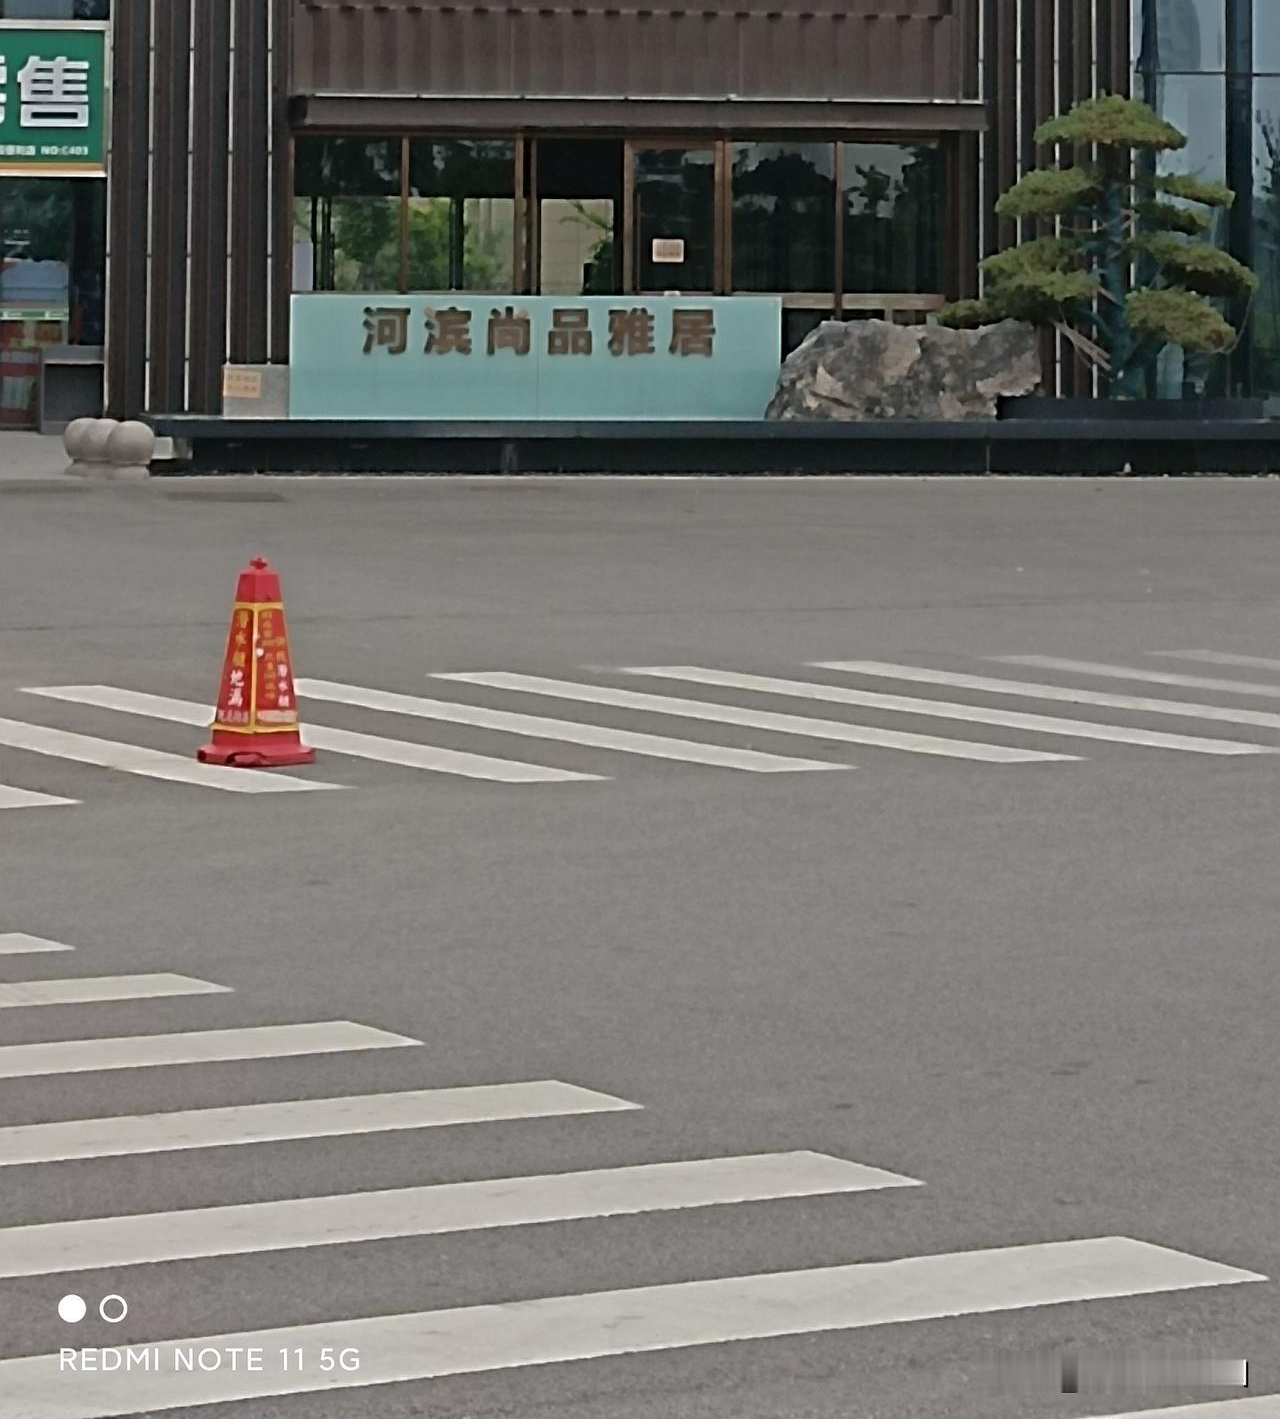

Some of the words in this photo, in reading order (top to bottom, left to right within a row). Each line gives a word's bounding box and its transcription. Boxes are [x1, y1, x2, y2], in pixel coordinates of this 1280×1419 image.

[0, 55, 89, 127] 售
[362, 306, 717, 357] 河滨尚品雅居
